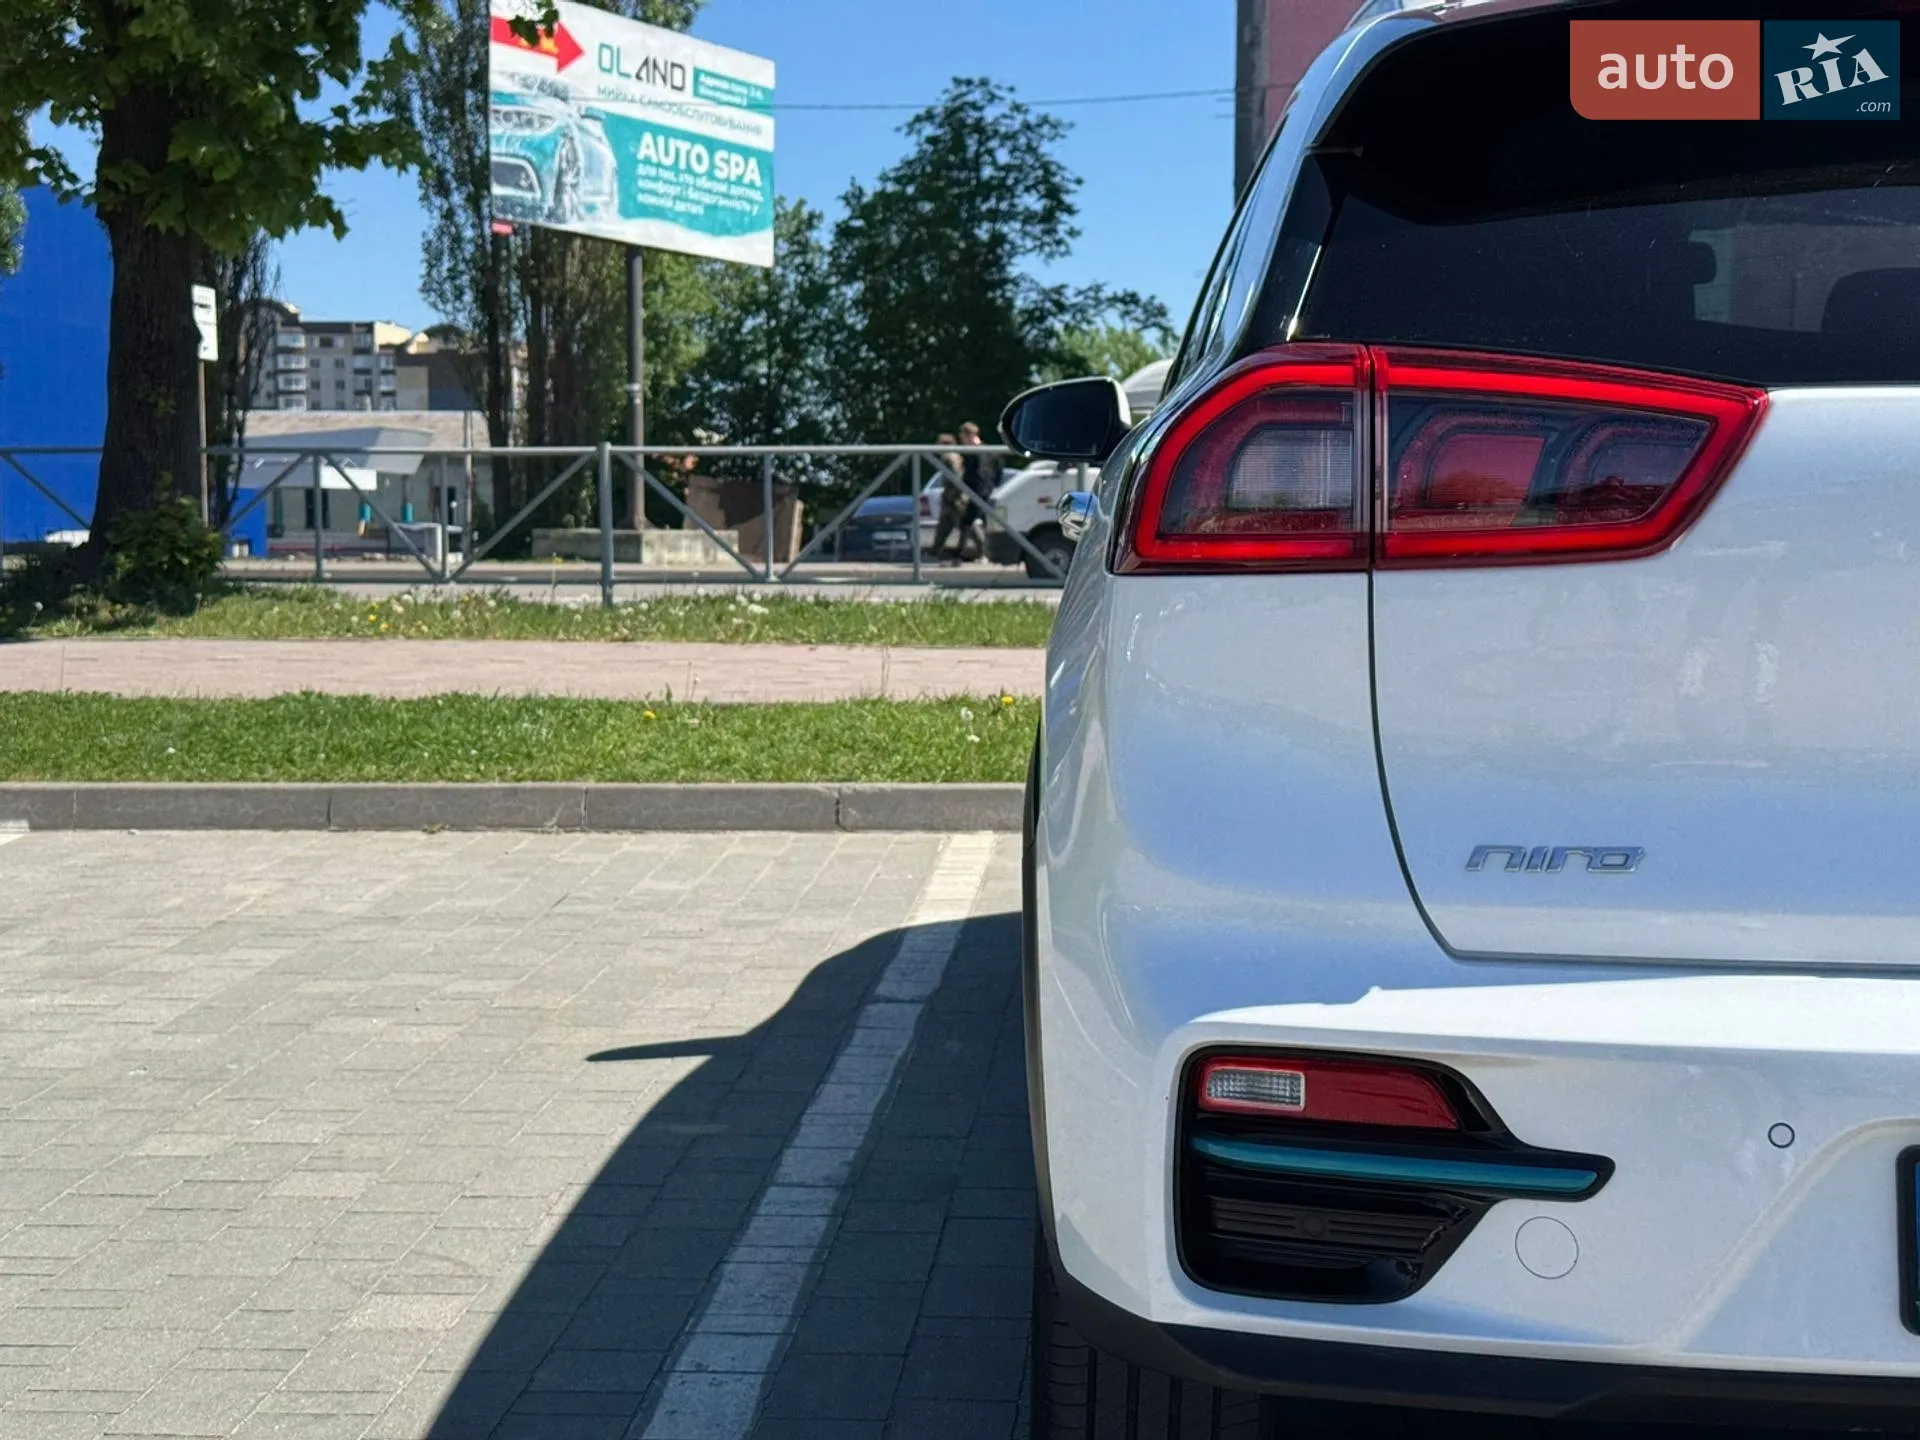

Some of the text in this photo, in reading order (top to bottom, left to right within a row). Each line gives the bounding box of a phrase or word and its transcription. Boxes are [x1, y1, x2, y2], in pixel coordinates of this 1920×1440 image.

[598, 42, 686, 92] OLAND
[637, 131, 762, 188] AUTO SPA
